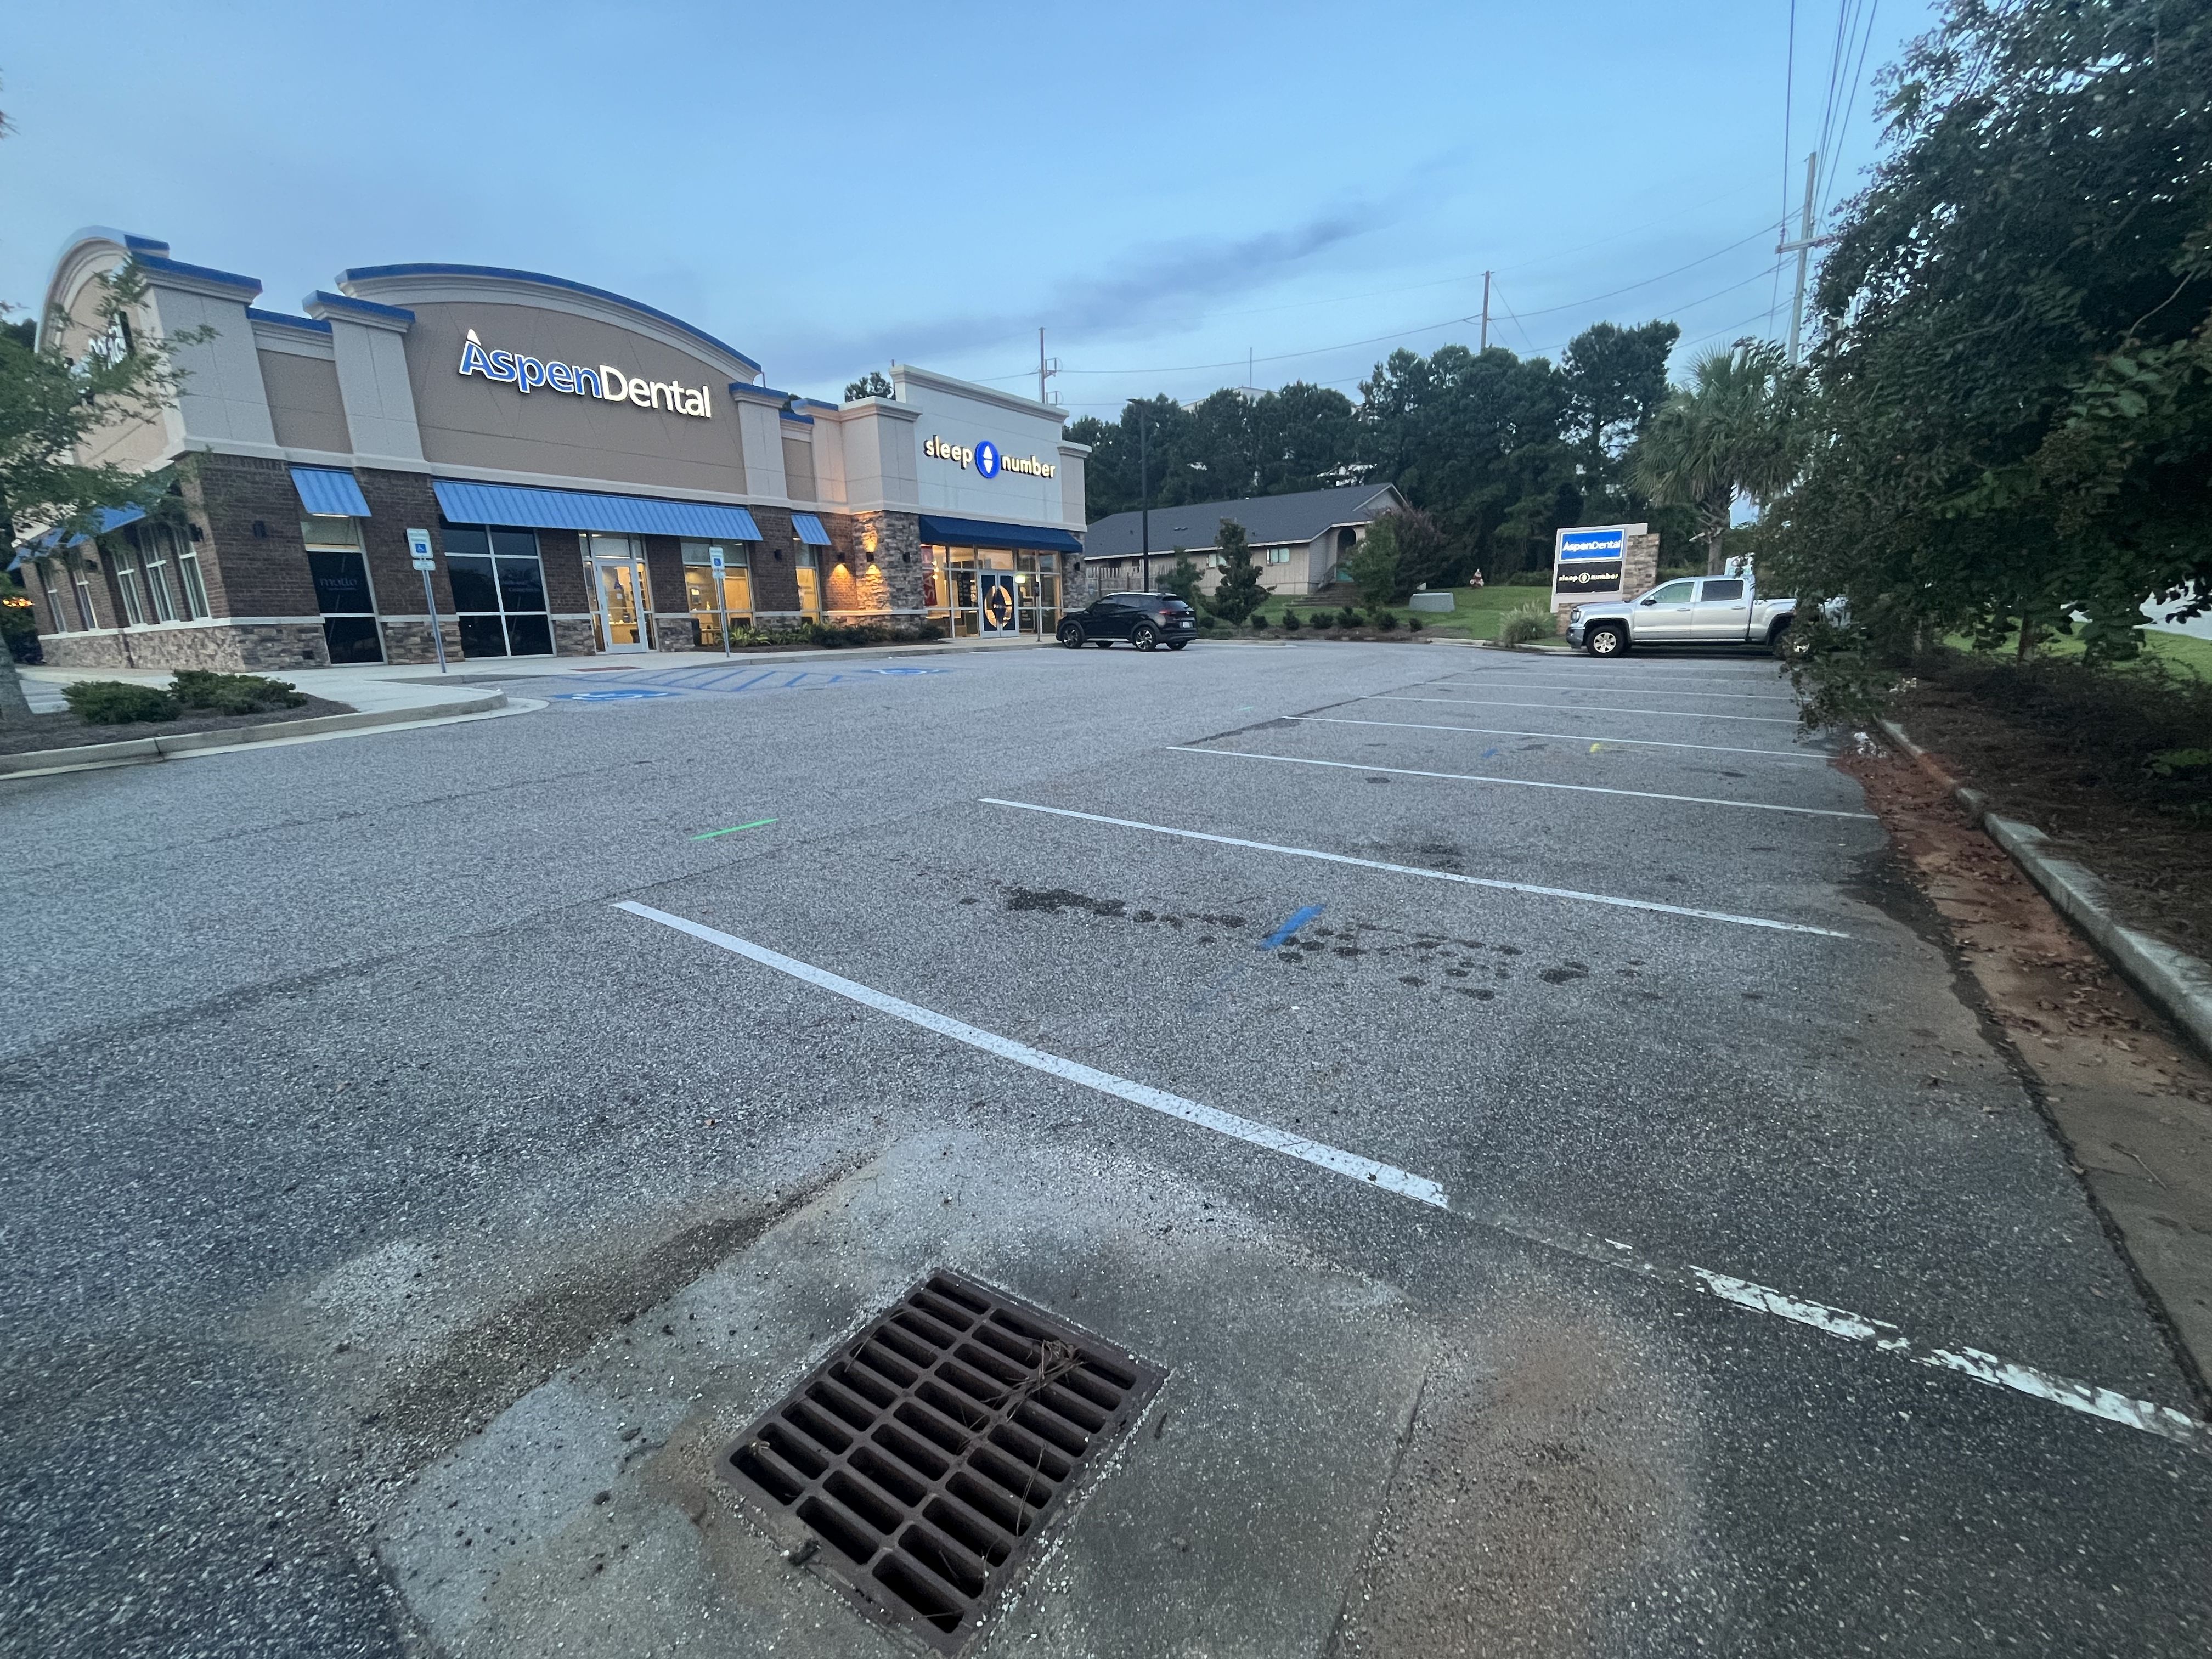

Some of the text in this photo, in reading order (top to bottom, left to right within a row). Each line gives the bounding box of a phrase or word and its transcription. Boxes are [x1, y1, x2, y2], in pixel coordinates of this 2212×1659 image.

[459, 329, 712, 418] AspenDental
[924, 435, 1056, 478] sleep number
[1562, 540, 1621, 552] AspenDental
